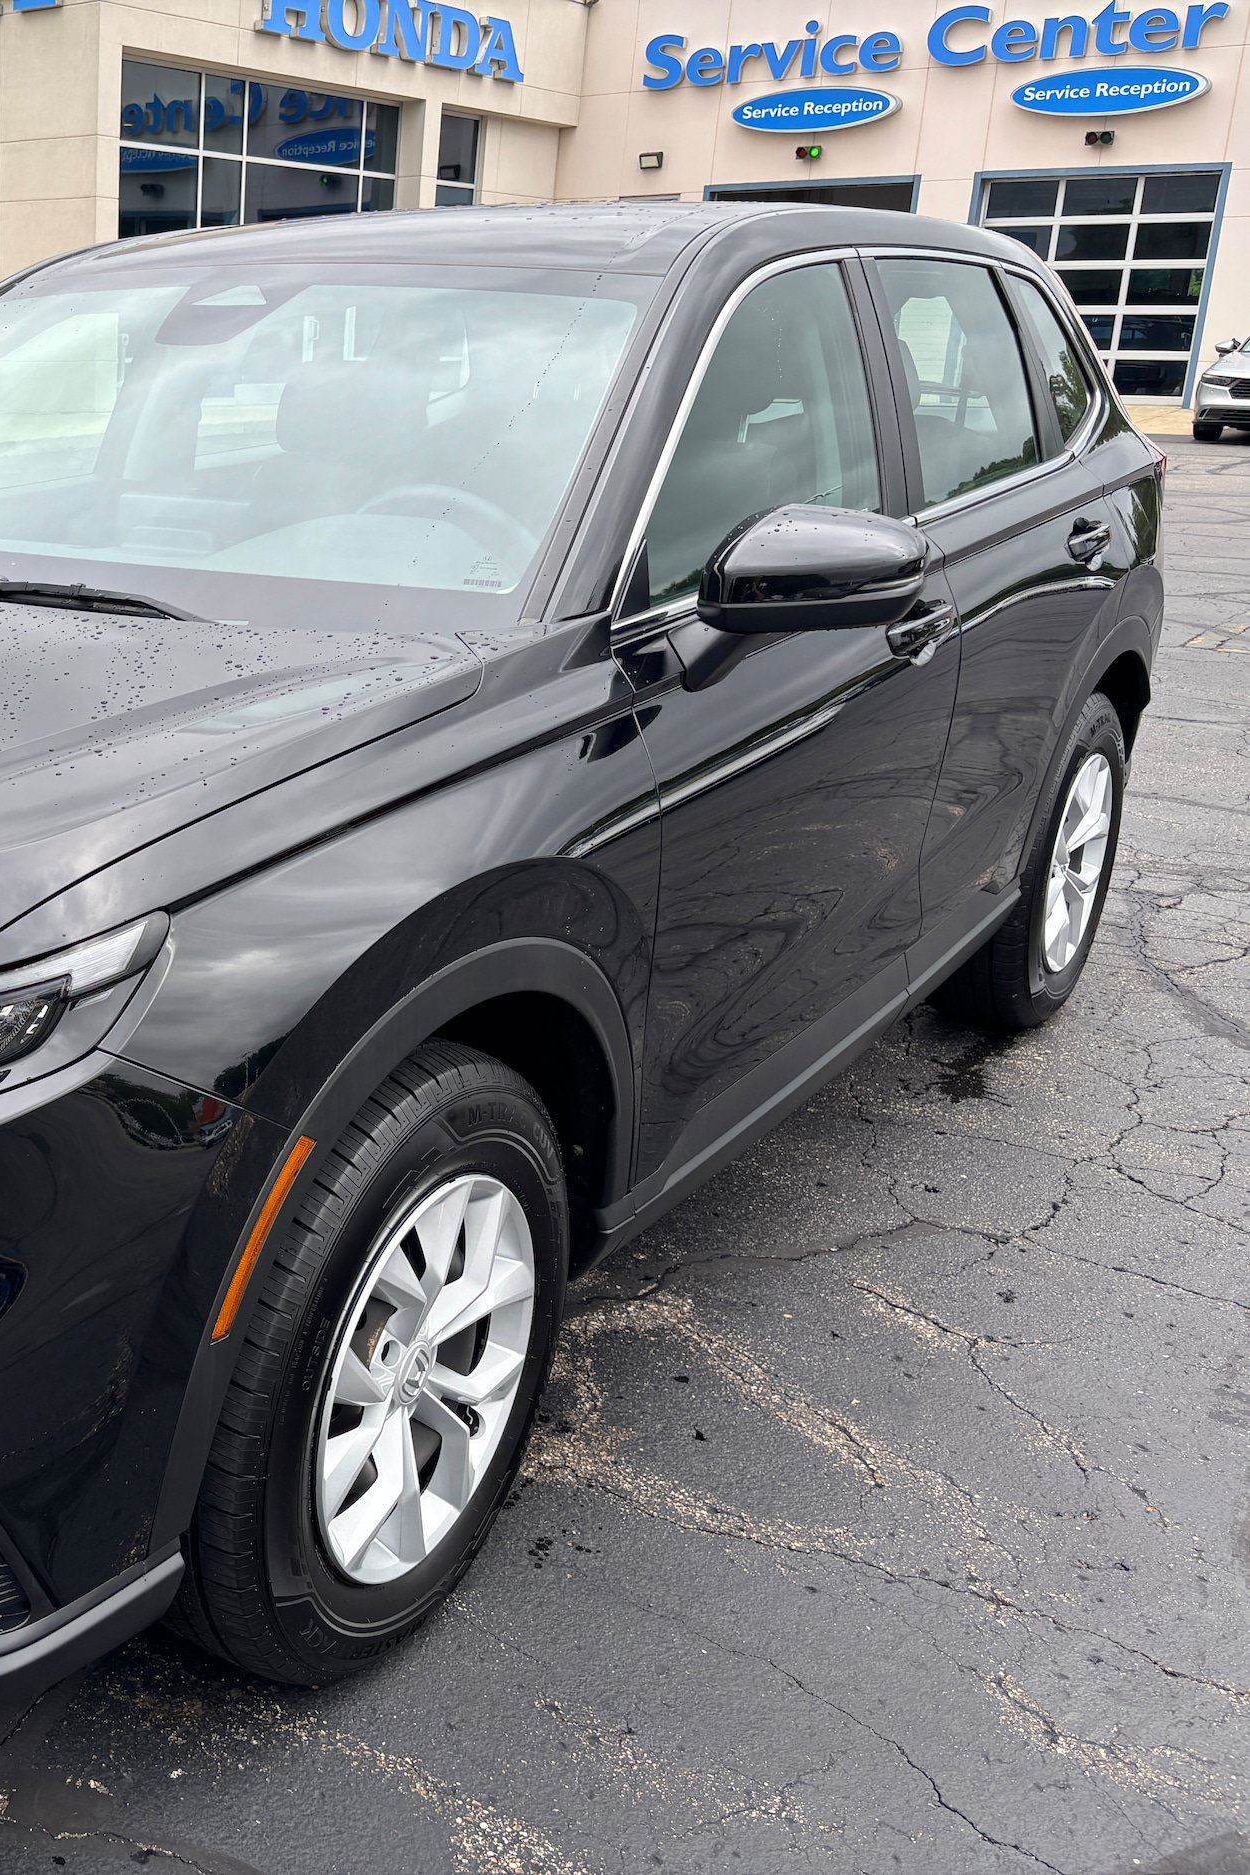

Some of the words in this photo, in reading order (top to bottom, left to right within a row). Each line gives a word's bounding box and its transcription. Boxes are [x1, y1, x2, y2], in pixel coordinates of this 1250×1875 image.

[262, 0, 524, 82] HONDA
[642, 19, 902, 91] Service
[927, 0, 1232, 66] Center
[742, 104, 799, 120] Service
[803, 98, 884, 118] Reception
[1023, 84, 1091, 102] Service
[1095, 78, 1192, 100] Reception
[302, 1316, 331, 1391] OUTSIDE
